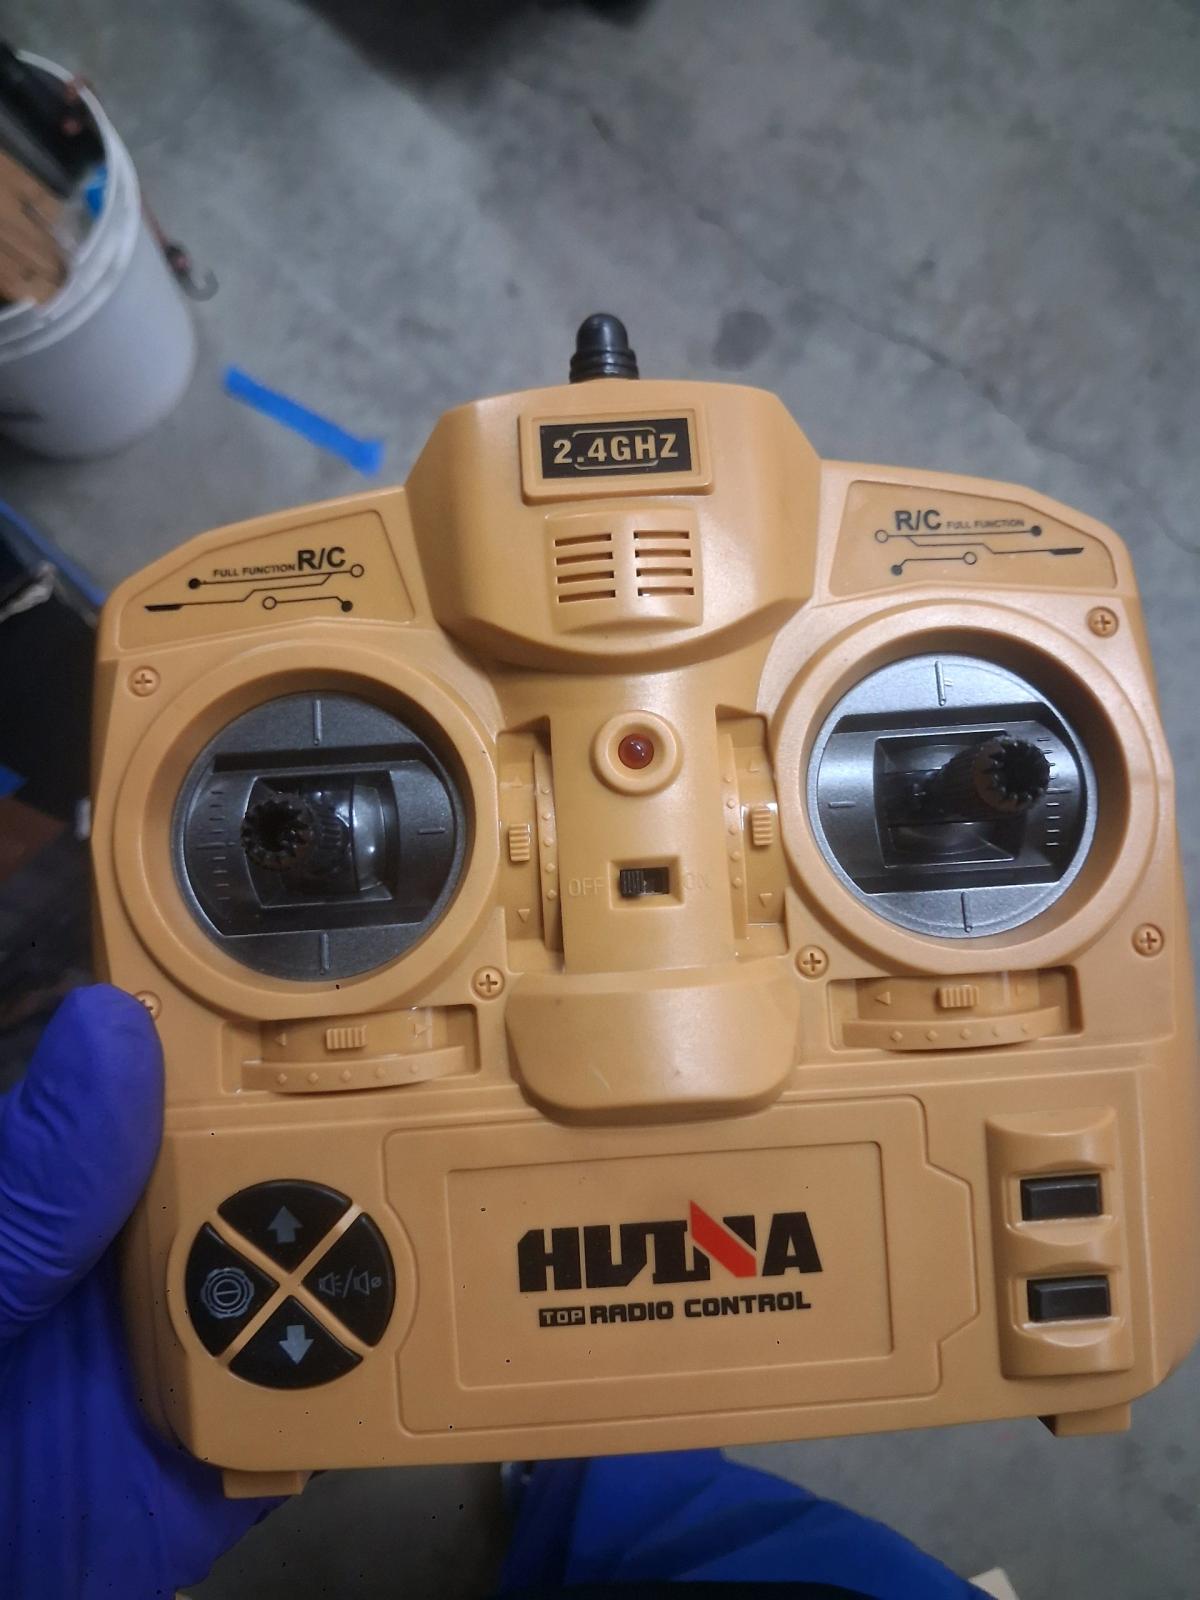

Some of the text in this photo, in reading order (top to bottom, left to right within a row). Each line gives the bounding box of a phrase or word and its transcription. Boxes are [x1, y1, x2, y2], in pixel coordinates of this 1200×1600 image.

[552, 433, 679, 464] 2.4GHZ
[894, 509, 1025, 531] R/C FULL FUNCTION
[213, 546, 346, 578] FULL FUNCTION R/C
[568, 877, 605, 897] OFF
[517, 1200, 823, 1292] HUINA
[541, 1291, 812, 1326] TOP RADIO CONTROL
